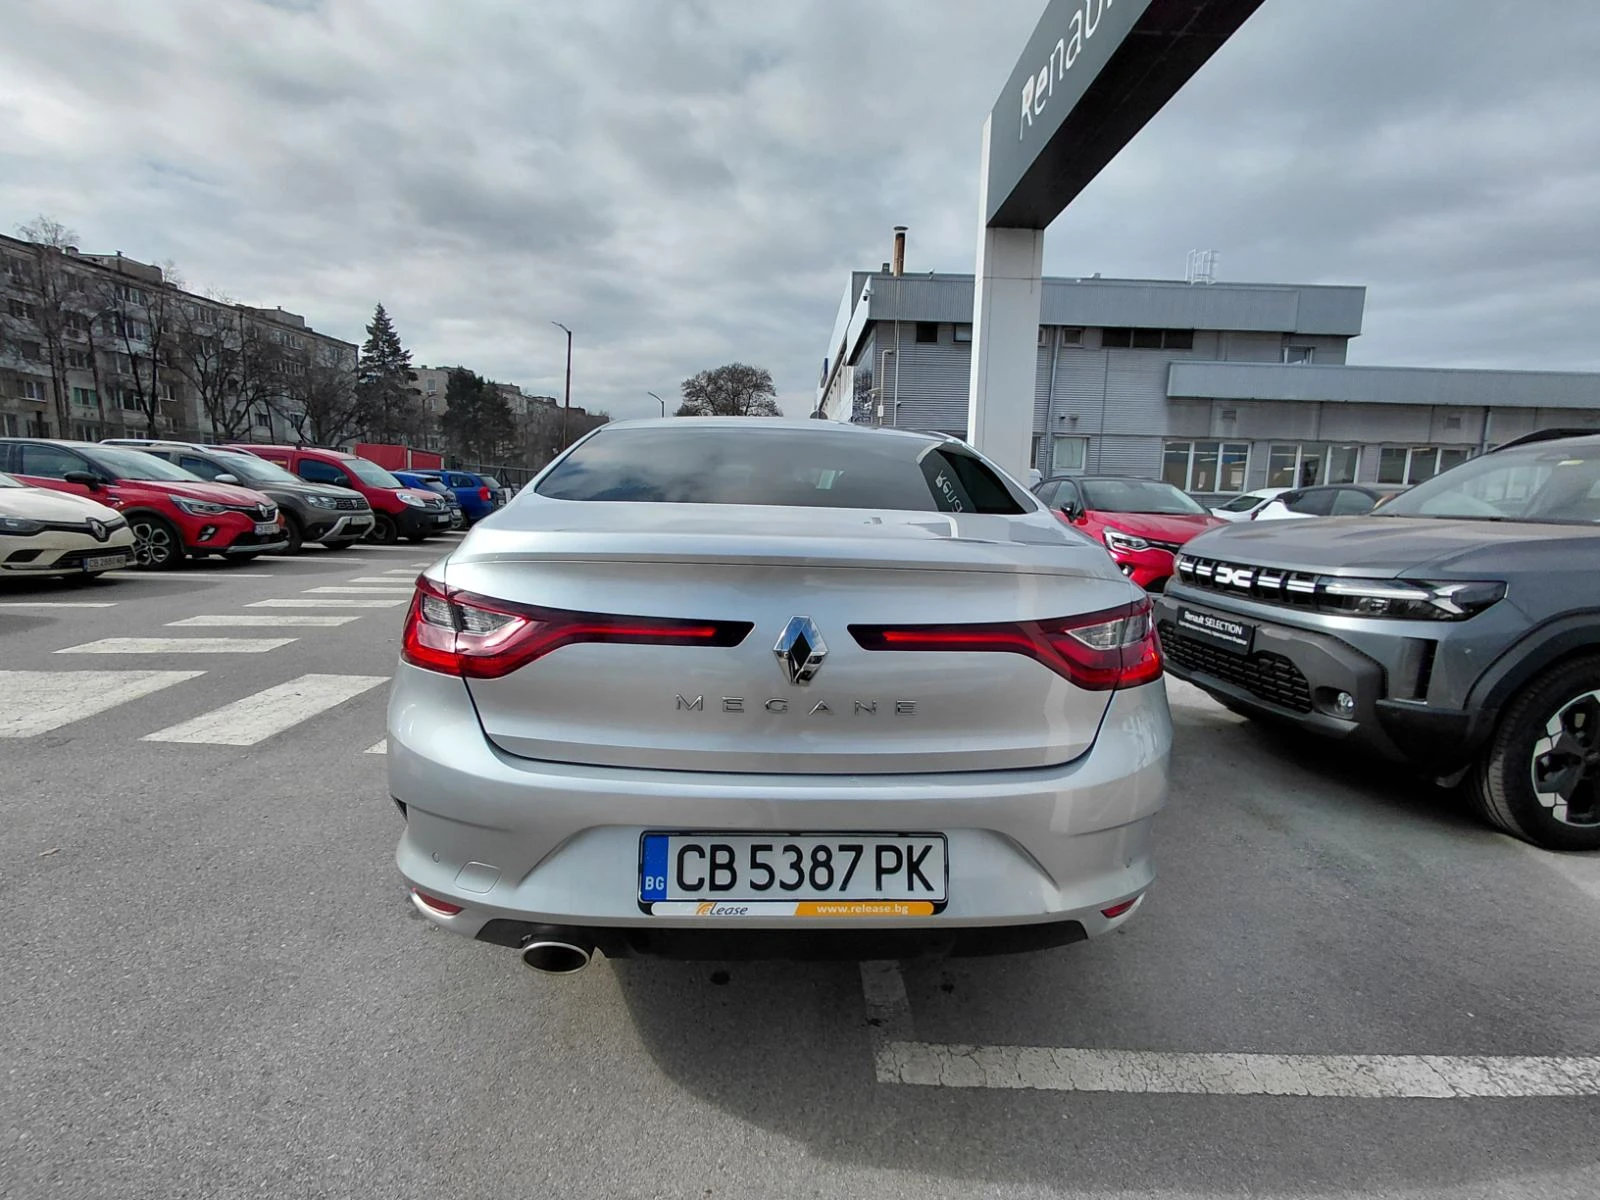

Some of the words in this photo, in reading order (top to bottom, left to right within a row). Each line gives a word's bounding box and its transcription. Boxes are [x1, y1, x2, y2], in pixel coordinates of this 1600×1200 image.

[1019, 0, 1113, 141] Renau
[1205, 615, 1243, 635] SELECTION
[675, 694, 918, 716] MEGANE
[676, 844, 738, 892] CB
[750, 844, 864, 892] 5387
[875, 844, 935, 892] PK
[645, 876, 665, 890] BG
[816, 903, 910, 916] www.release.bg
